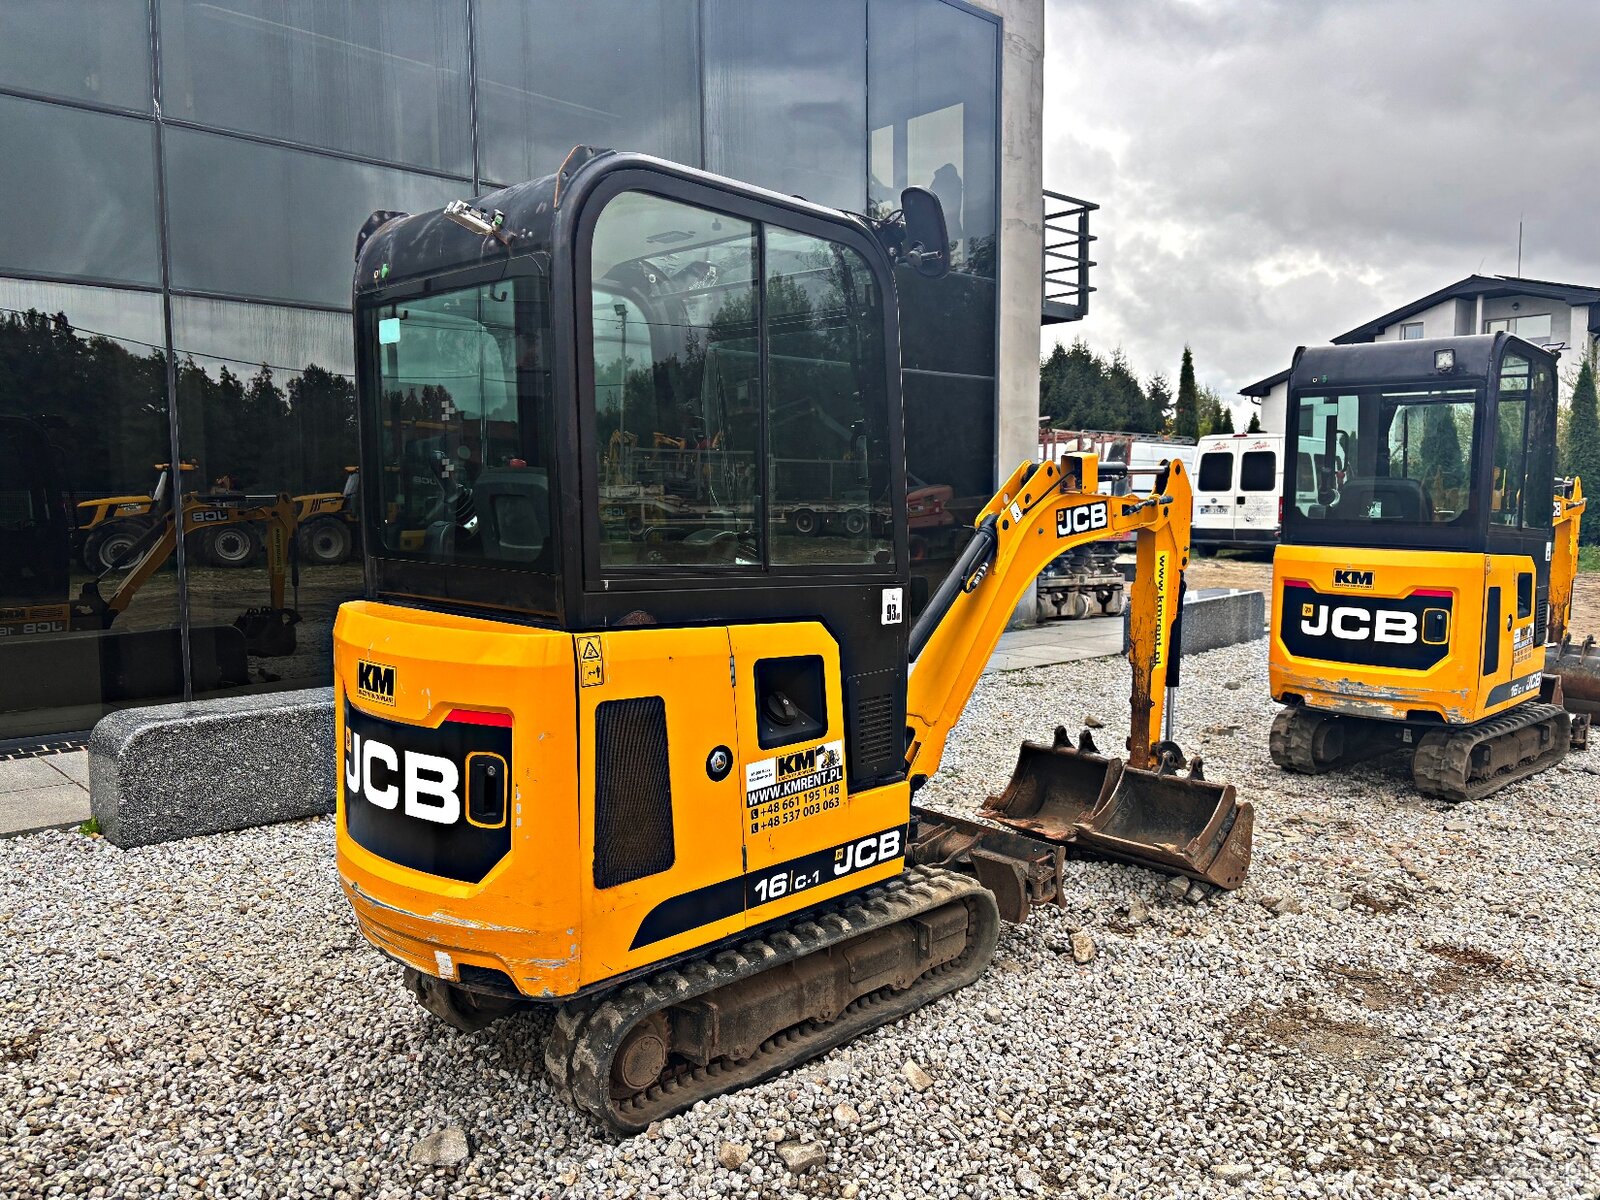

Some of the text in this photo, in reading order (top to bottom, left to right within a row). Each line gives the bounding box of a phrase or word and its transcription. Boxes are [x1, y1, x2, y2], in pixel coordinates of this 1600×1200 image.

[1058, 501, 1107, 535] JCB
[1335, 570, 1373, 586] KM
[887, 604, 897, 621] 93
[1156, 554, 1165, 665] wwwkmrentpl
[1300, 605, 1418, 644] JCB
[359, 661, 395, 697] KM
[1526, 672, 1541, 691] JCB
[345, 731, 461, 825] JCB
[778, 749, 815, 776] KM
[747, 766, 843, 806] WWW.KMRENT.PL
[761, 784, 840, 817] +48 661 195 148
[761, 797, 840, 830] +48 537 003 063
[834, 830, 901, 876] JCB
